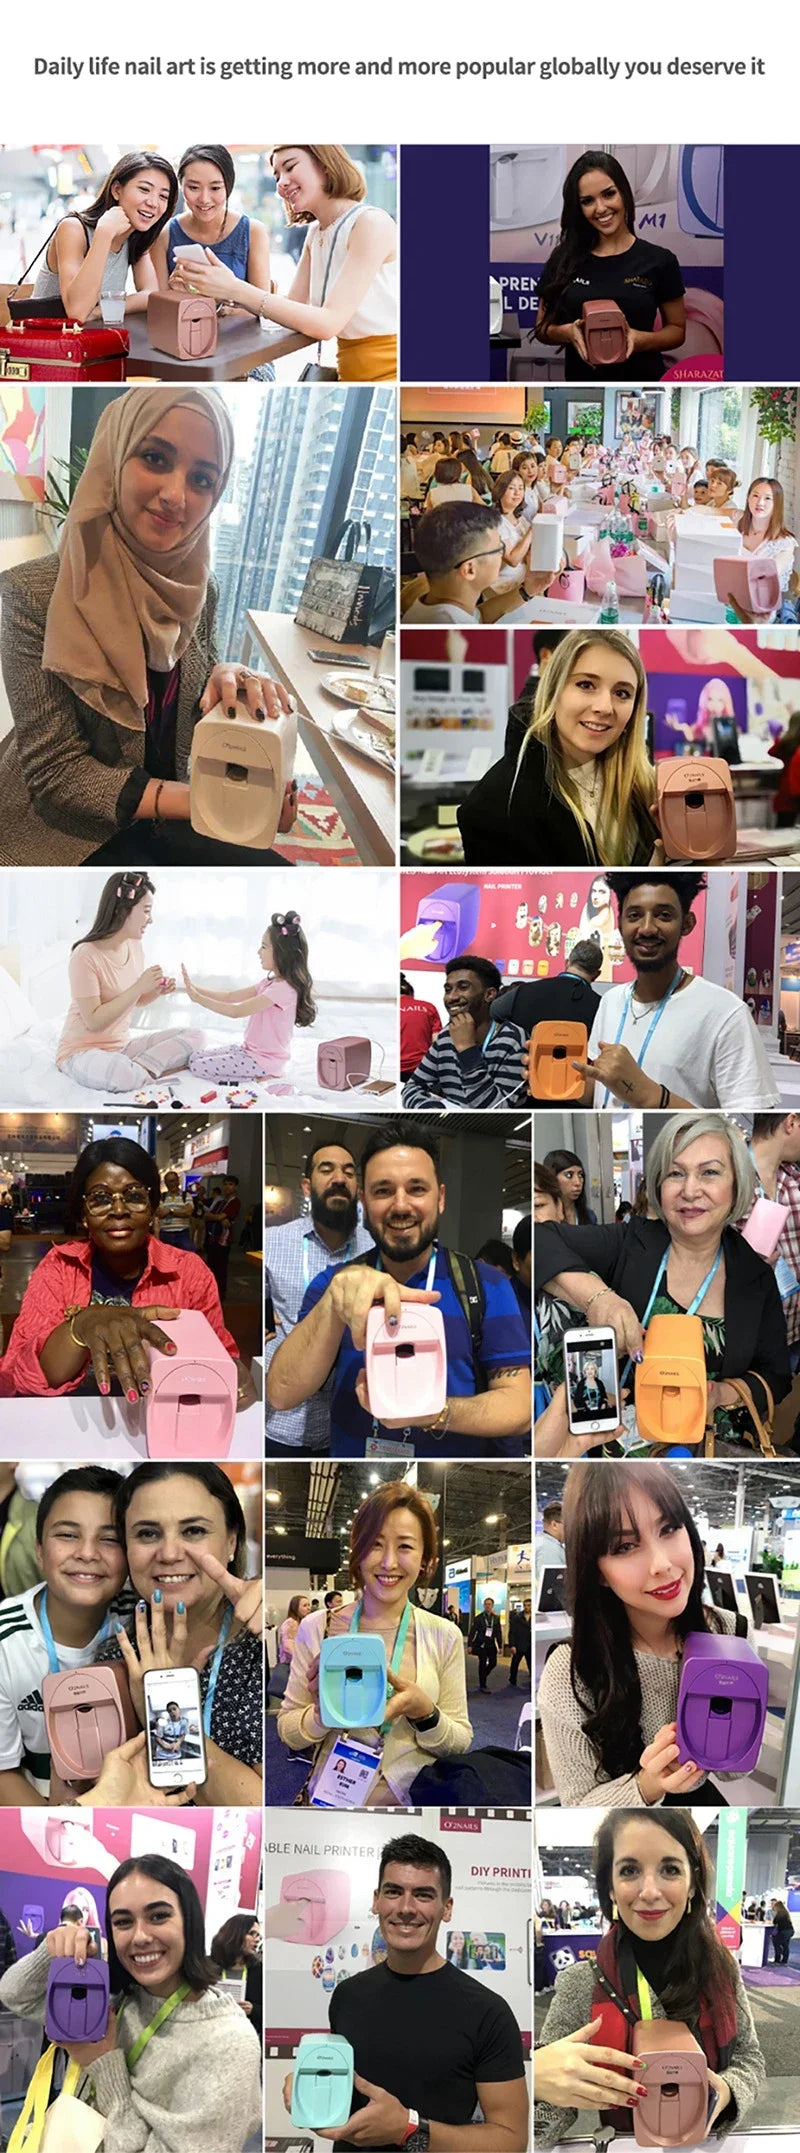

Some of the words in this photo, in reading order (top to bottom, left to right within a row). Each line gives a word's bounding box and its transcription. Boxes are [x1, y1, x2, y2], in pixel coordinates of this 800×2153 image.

[638, 213, 666, 229] M1
[518, 296, 539, 310] DE
[293, 1843, 321, 1855] NAIL
[323, 1844, 375, 1858] PRINTER
[471, 1866, 490, 1877] DIY
